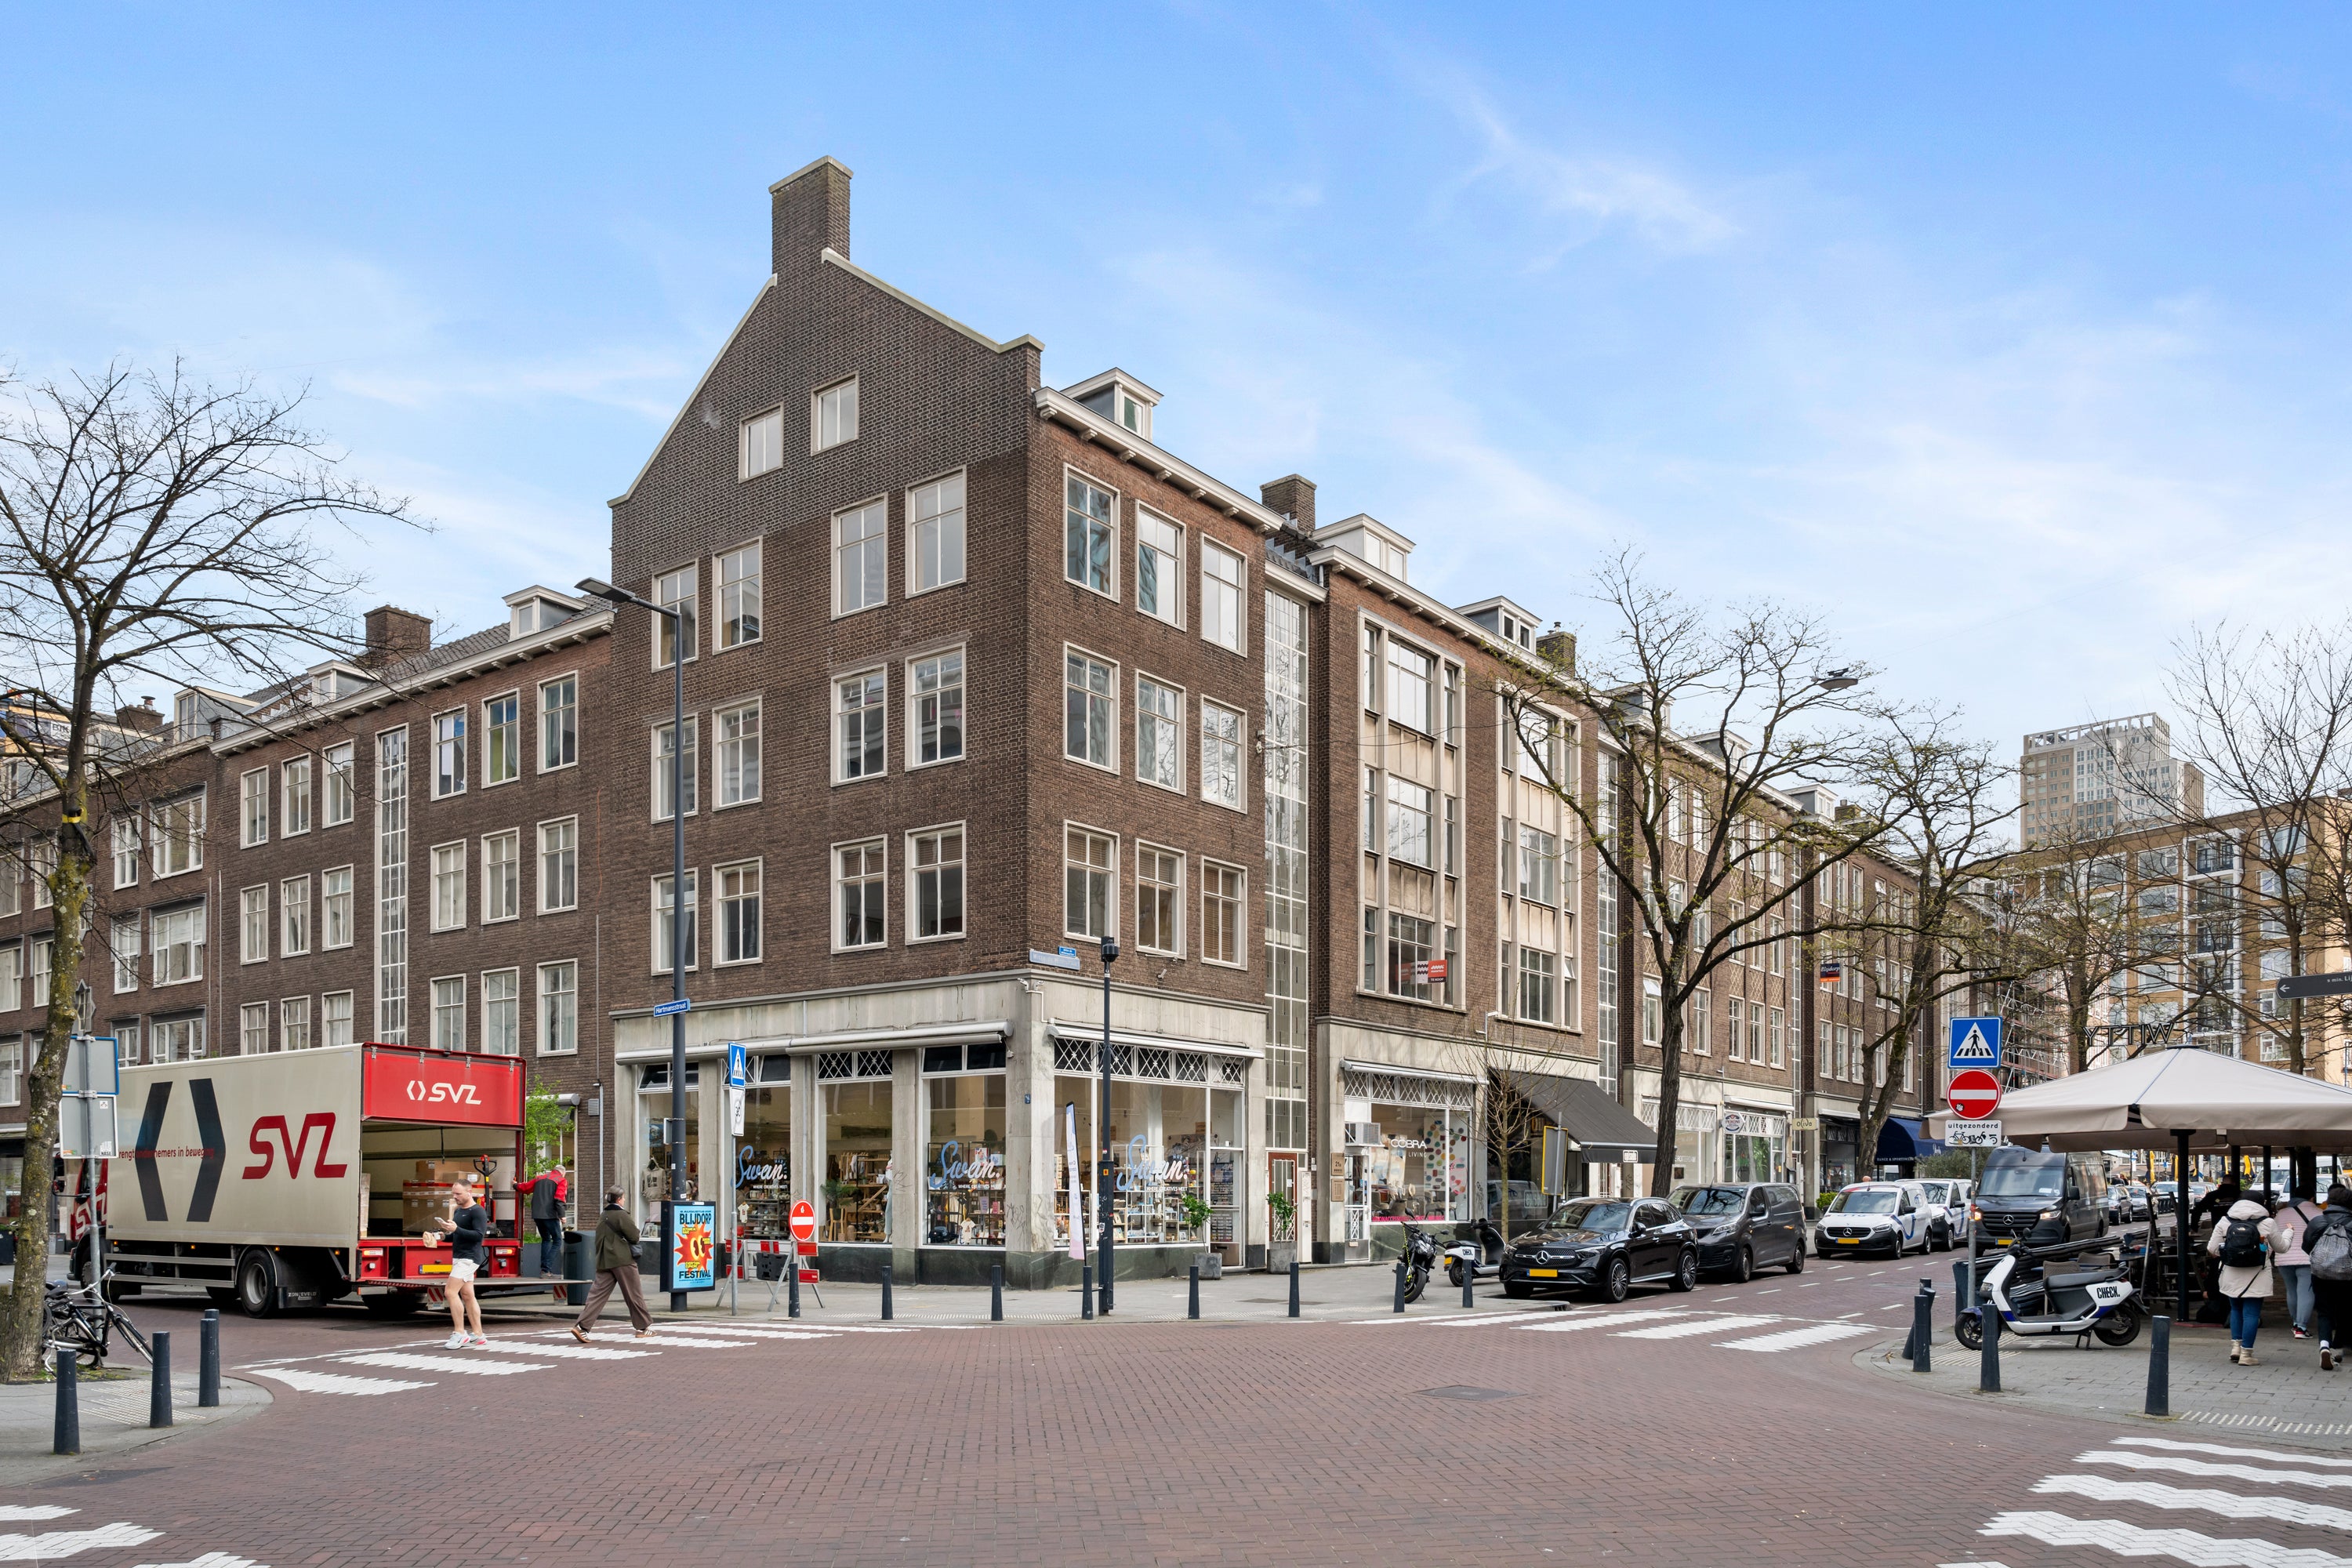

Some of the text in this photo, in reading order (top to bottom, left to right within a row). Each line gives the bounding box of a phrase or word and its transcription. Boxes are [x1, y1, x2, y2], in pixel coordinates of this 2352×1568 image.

[427, 1082, 482, 1105] SVZ
[241, 1112, 348, 1180] SVZ
[1390, 1138, 1428, 1149] COBRA
[177, 1146, 184, 1157] in
[679, 1213, 712, 1225] BLIJDORP
[679, 1269, 712, 1279] FESTIVAL
[2096, 1286, 2121, 1299] CHECK.
